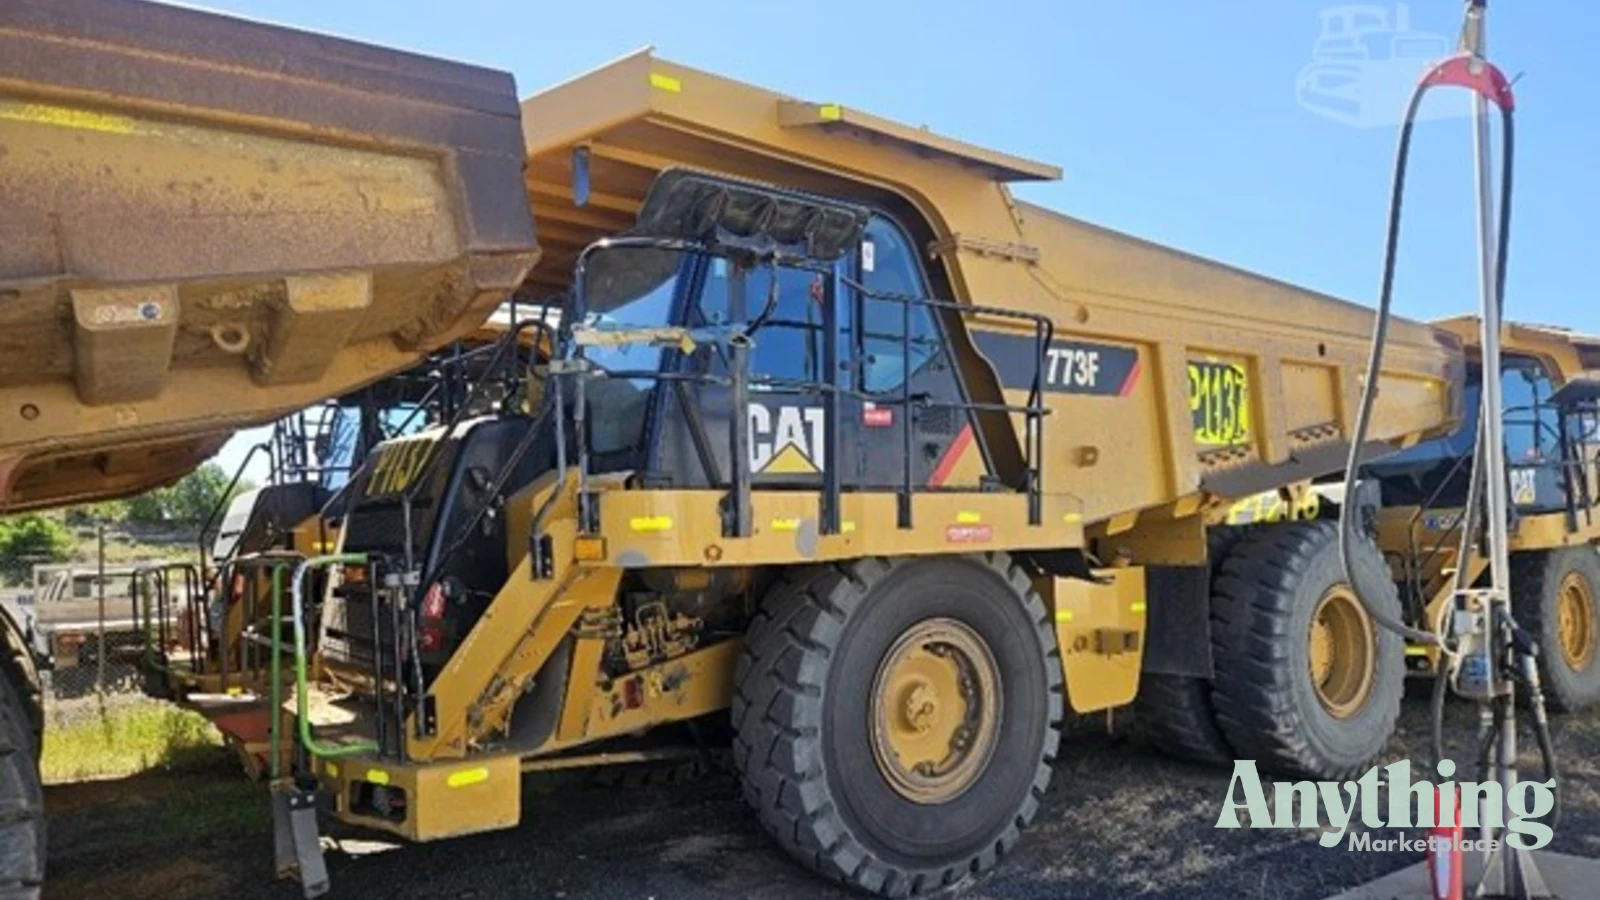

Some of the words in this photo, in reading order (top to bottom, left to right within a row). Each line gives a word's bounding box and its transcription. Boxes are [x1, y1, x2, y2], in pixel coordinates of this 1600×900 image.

[1047, 349, 1099, 387] 773F
[748, 403, 824, 473] CAT
[1187, 363, 1248, 444] P1137
